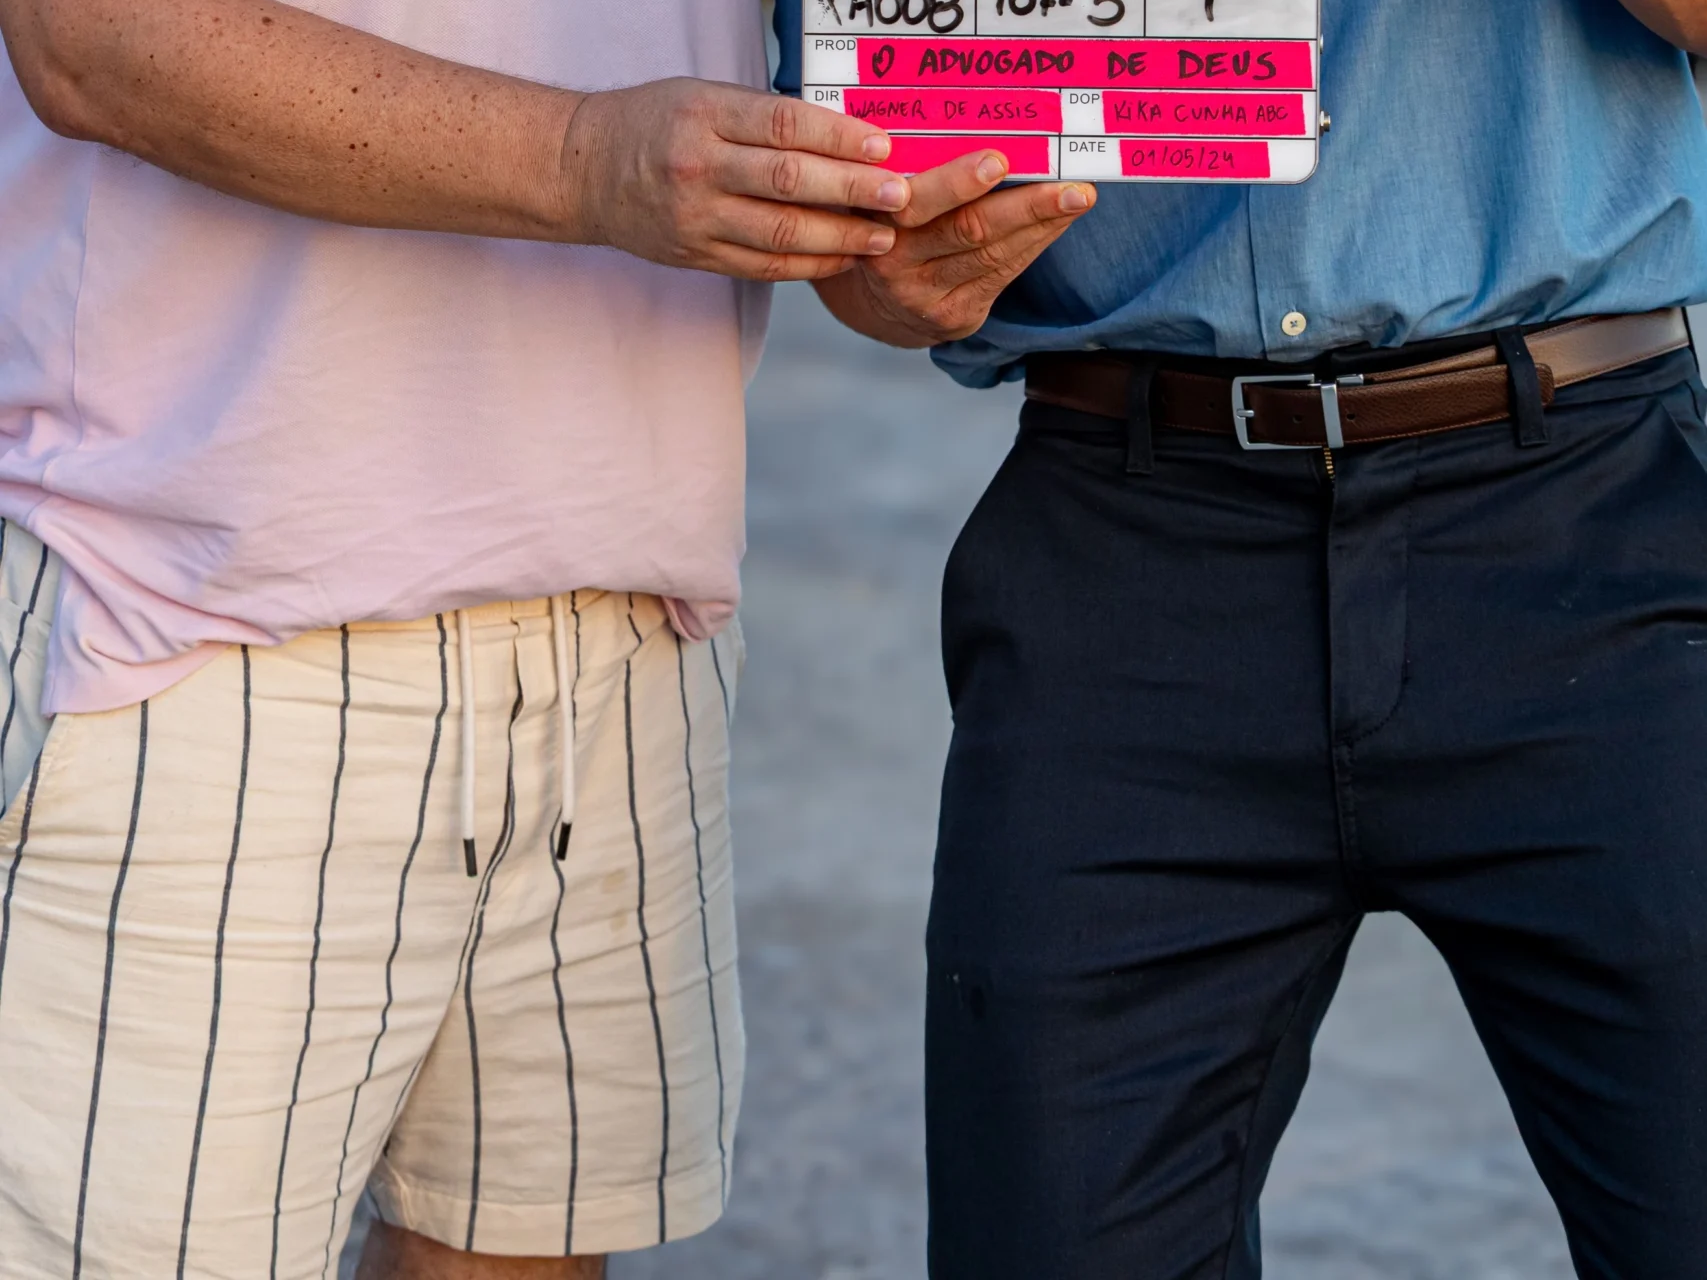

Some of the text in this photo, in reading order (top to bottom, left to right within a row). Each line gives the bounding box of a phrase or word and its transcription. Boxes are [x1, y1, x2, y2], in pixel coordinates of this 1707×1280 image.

[815, 39, 856, 51] PROD
[872, 44, 1277, 80] O ADVOGADO DE DEUS
[814, 90, 840, 102] DIR
[1069, 92, 1100, 104] DOP
[849, 99, 927, 120] WAGNER
[944, 100, 968, 121] DE
[1173, 103, 1247, 124] CUNHA
[1255, 104, 1288, 123] ABC
[1069, 141, 1106, 153] DATE
[1130, 145, 1234, 171] 01/05/24
